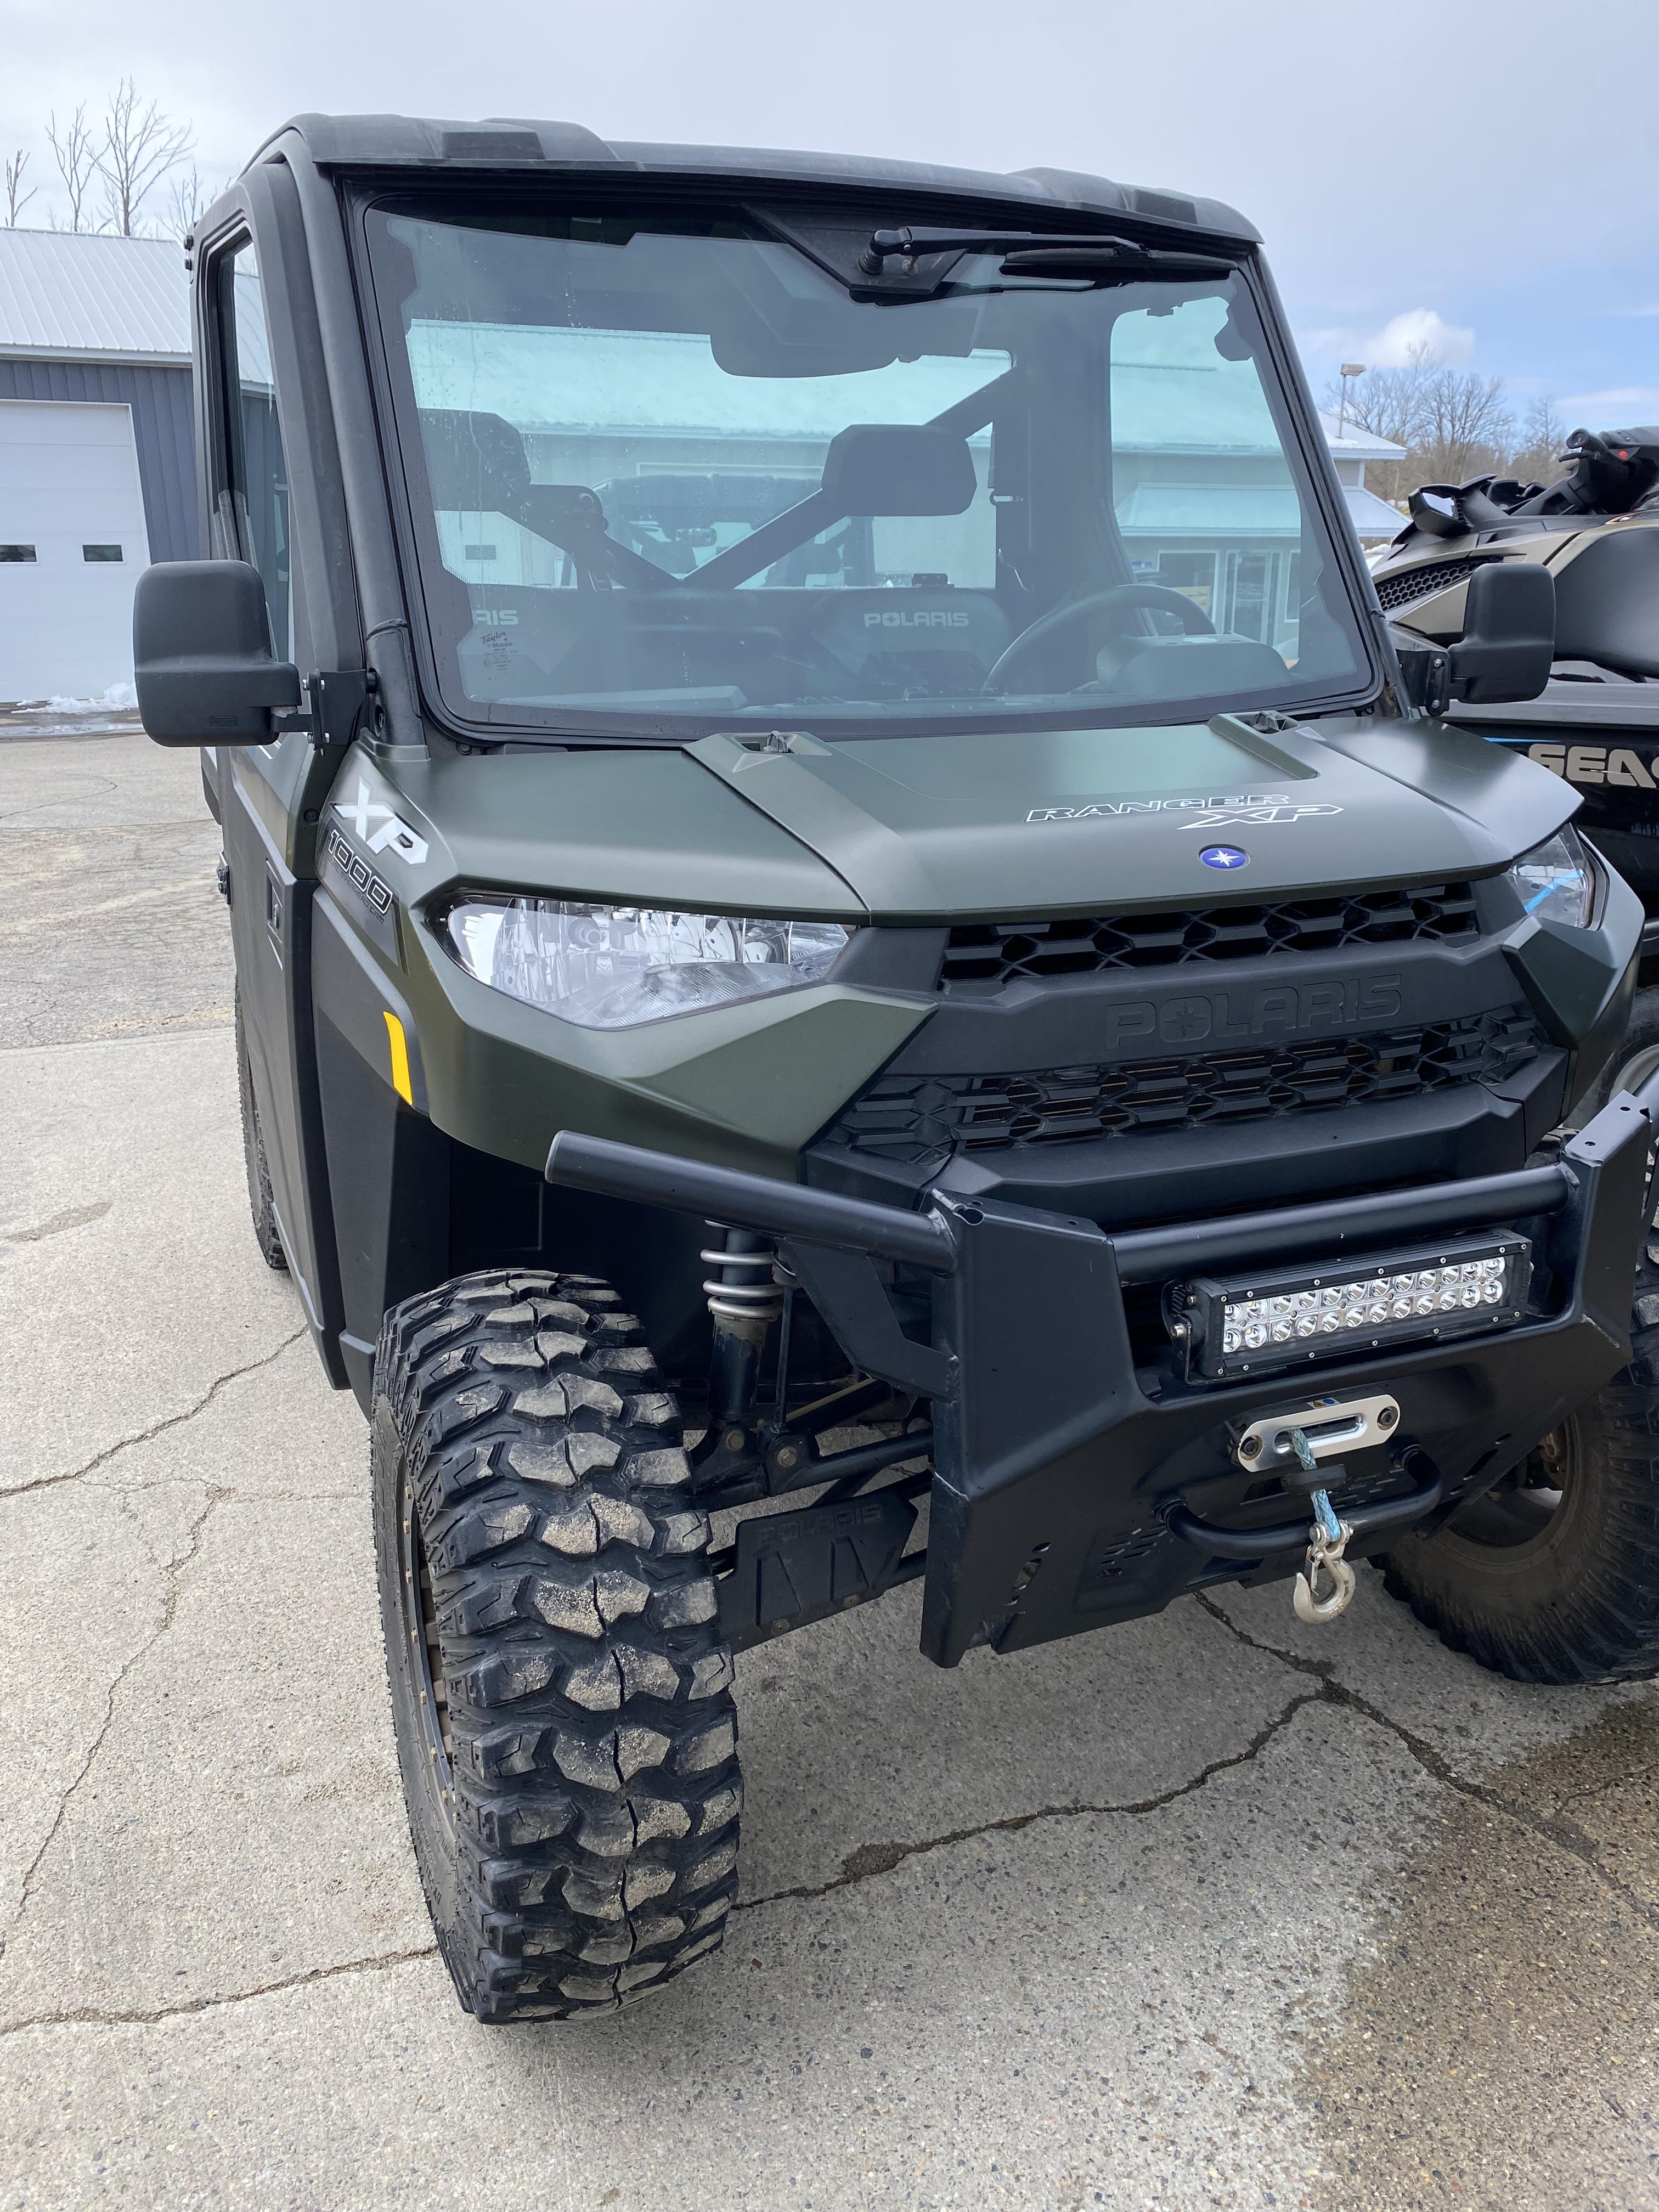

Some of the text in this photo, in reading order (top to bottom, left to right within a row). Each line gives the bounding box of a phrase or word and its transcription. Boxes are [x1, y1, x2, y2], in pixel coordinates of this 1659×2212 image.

[480, 631, 506, 644] Taylor
[864, 612, 969, 628] POLARIS
[330, 775, 430, 867] XP
[1025, 793, 1291, 822] RANGER
[1177, 804, 1345, 830] XP
[328, 829, 393, 915] 1000
[340, 873, 369, 908] OVERHEAD
[369, 906, 385, 925] CAM
[1105, 973, 1402, 1049] POLARIS
[758, 1505, 882, 1546] POLARIS
